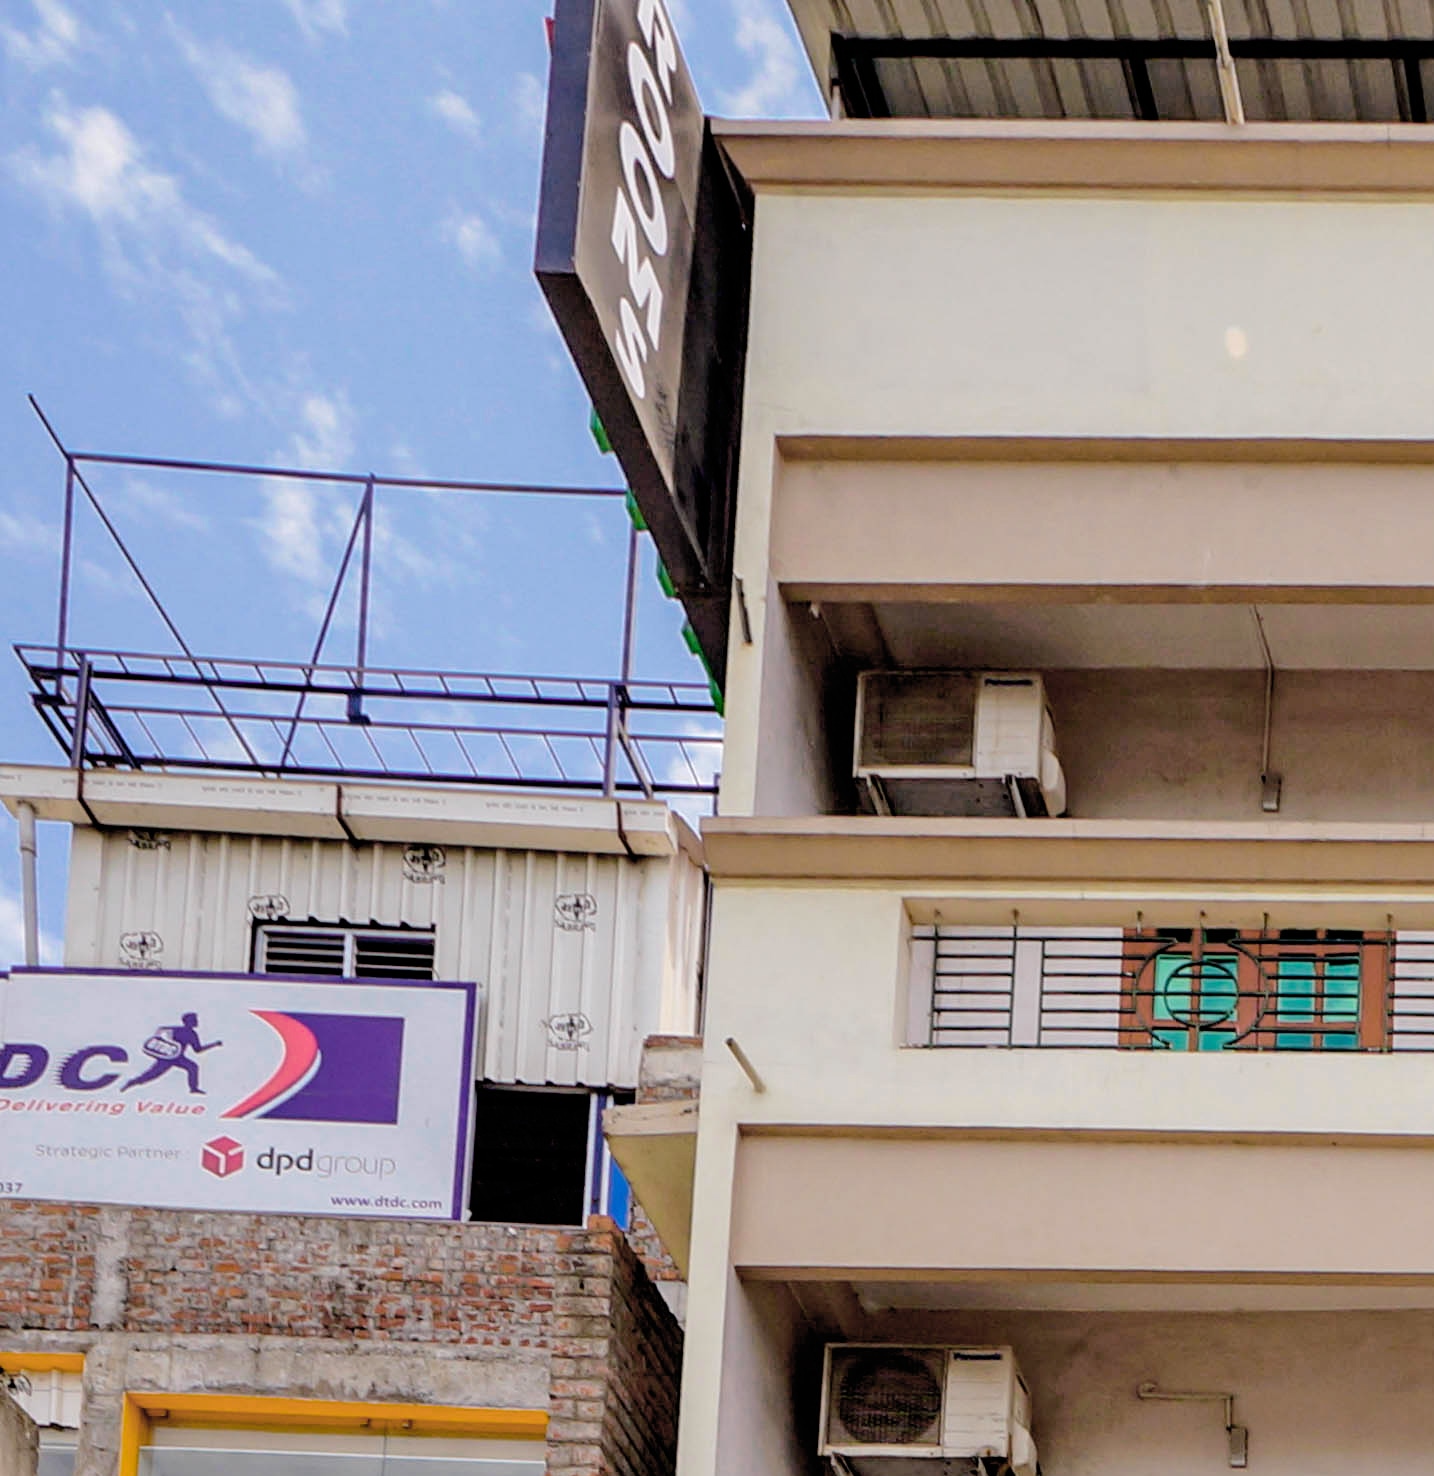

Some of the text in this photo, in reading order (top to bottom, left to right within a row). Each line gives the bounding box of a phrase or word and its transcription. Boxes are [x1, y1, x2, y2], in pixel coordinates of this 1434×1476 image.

[137, 1100, 206, 1115] Value
[35, 1144, 181, 1160] Strategic Partner
[256, 1147, 397, 1179] dpdgroup
[330, 1195, 443, 1209] www.dtdc.com
